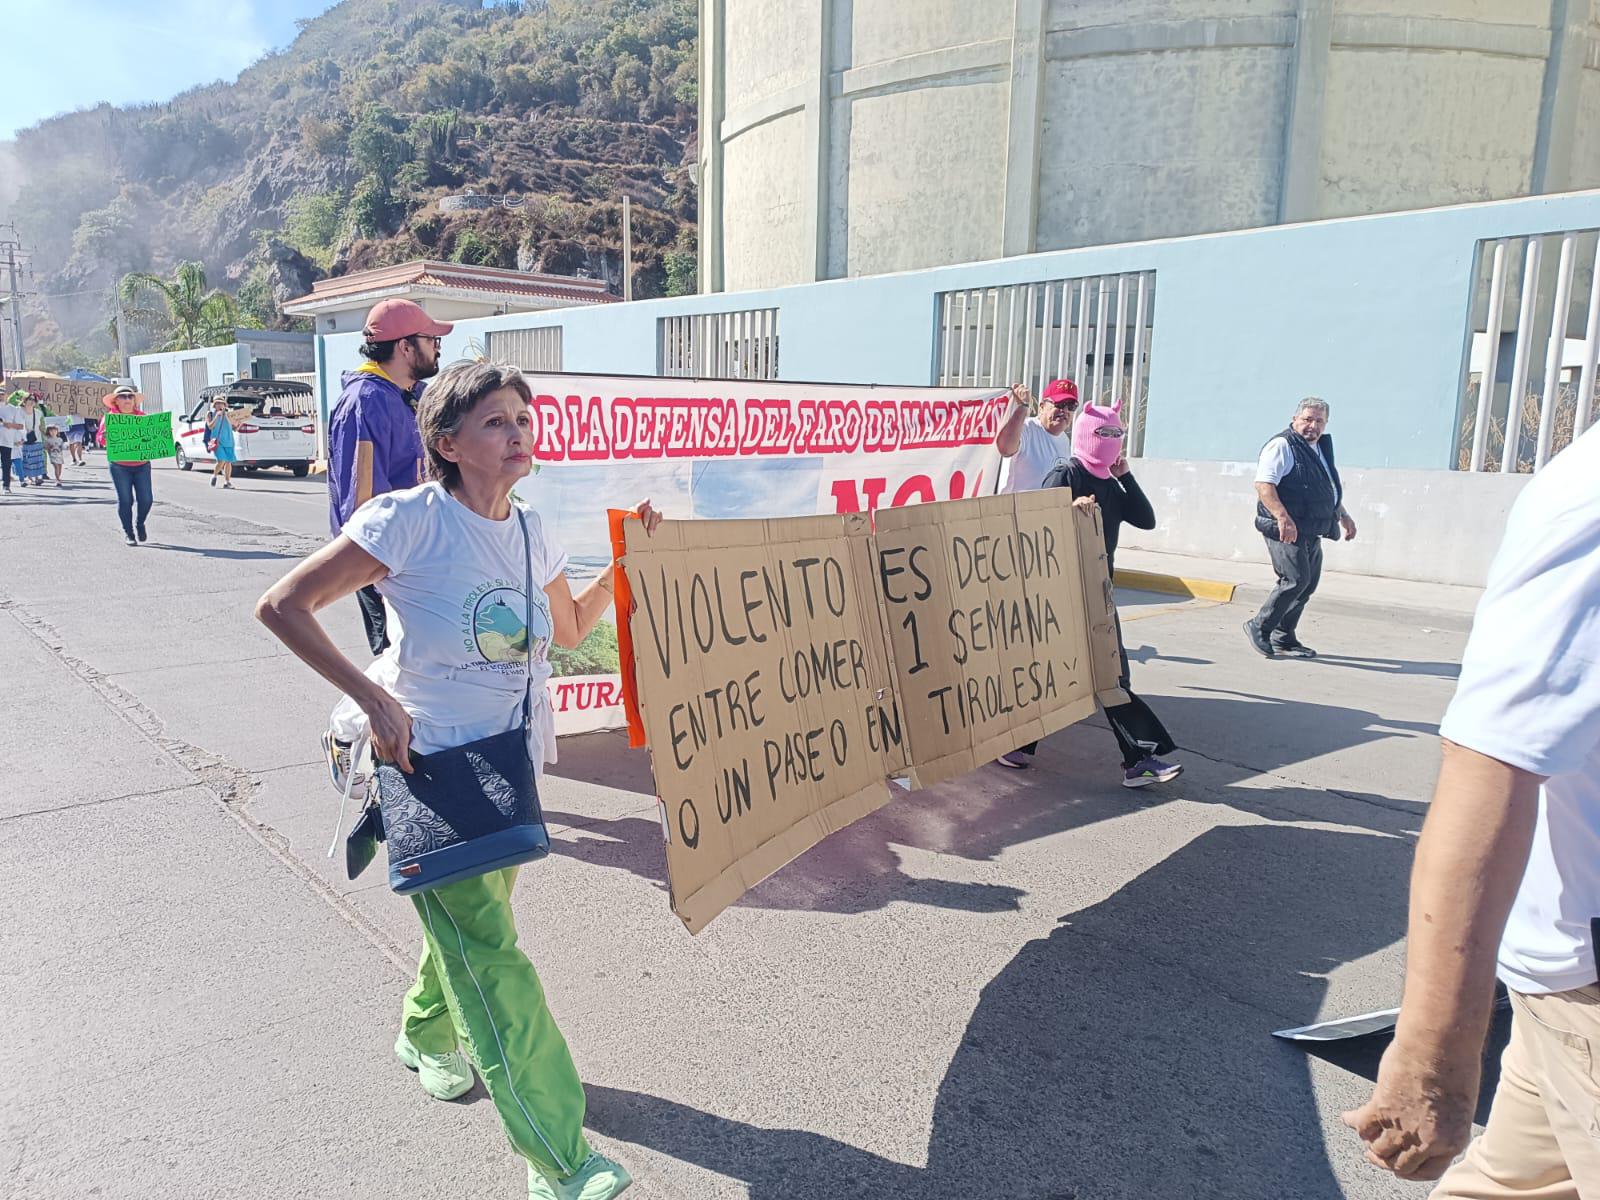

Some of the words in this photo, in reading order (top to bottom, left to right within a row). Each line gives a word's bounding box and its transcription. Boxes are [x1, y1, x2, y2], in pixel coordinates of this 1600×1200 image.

[567, 400, 608, 456] LA
[612, 401, 738, 455] DEFENSA
[741, 402, 793, 452] DEL
[795, 403, 863, 450] FARO
[863, 404, 898, 449] DE
[464, 638, 475, 653] NO
[639, 557, 846, 679] VIOLENTO
[879, 546, 932, 604] ES
[953, 526, 1061, 590] DECIDIR
[669, 670, 766, 771] ENTRE
[779, 639, 869, 703] COMER
[902, 610, 930, 675] 1
[948, 593, 1062, 665] SEMANA
[678, 798, 700, 850] O
[714, 758, 752, 824] UN
[763, 719, 848, 802] PASEO
[865, 699, 902, 753] EN
[927, 660, 1058, 735] TIROLESA
